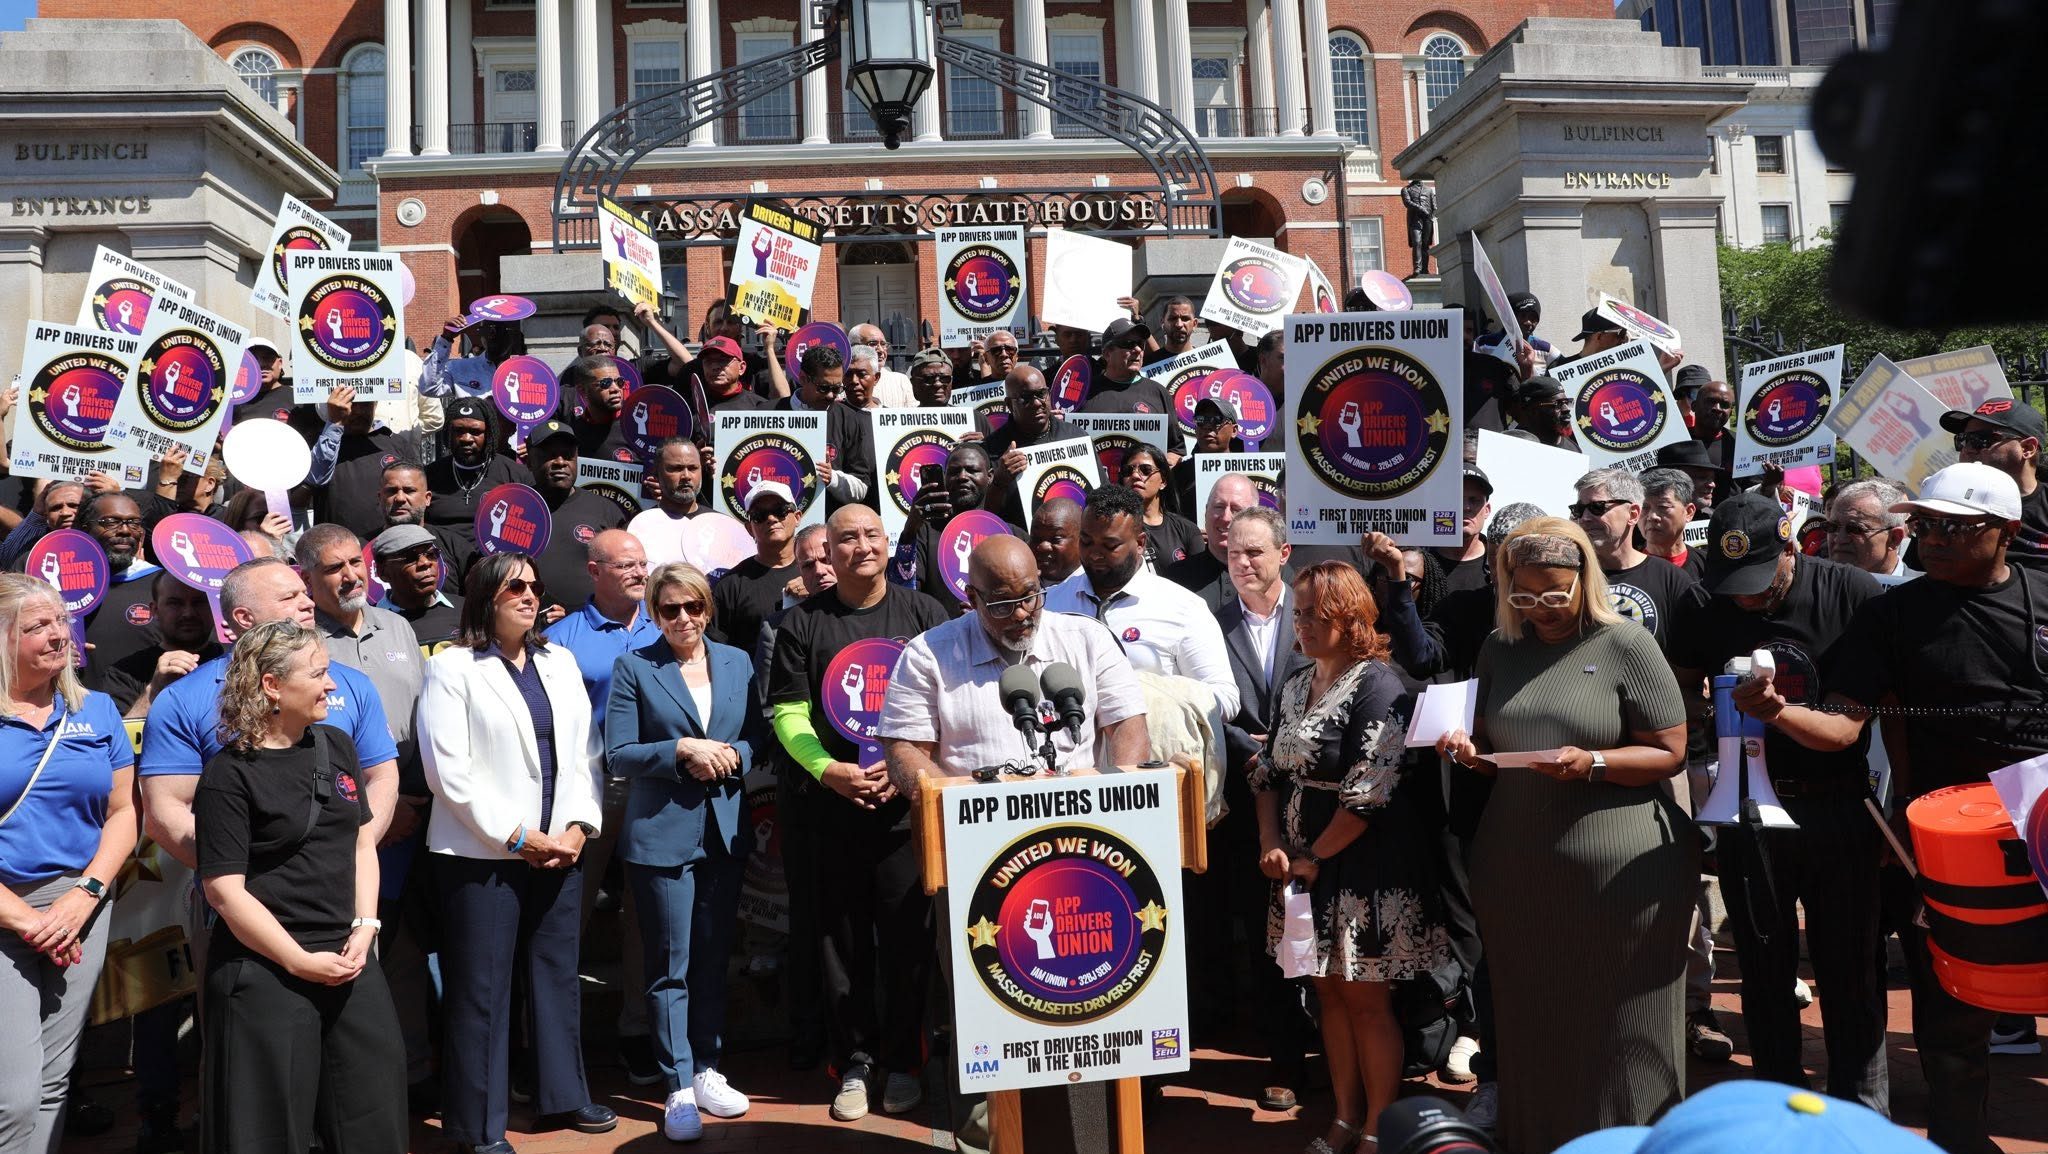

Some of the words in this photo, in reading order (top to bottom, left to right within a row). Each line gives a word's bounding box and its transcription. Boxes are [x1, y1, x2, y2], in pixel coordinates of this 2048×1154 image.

[1564, 126, 1663, 142] BULFINCH
[15, 143, 148, 161] BULFINCH
[1564, 172, 1671, 188] ENTRANCE
[12, 195, 152, 216] ENTRANCE
[603, 197, 634, 226] DRIVERS
[287, 200, 301, 214] APP
[301, 209, 327, 232] DRIVERS
[327, 226, 346, 244] UNION
[641, 203, 918, 231] ASSAUSETTS
[931, 201, 1029, 225] STATE
[1042, 199, 1157, 223] HOUSE
[752, 204, 792, 232] DRIVERS
[793, 220, 812, 240] WIN
[774, 236, 793, 252] APP
[941, 232, 956, 242] APP
[959, 231, 992, 242] DRIVERS
[994, 230, 1018, 241] UNION
[1234, 240, 1249, 250] APP
[294, 256, 315, 269] APP
[318, 257, 360, 270] DRIVERS
[364, 258, 393, 271] UNION
[772, 248, 809, 272] DRIVERS
[954, 250, 977, 268] UNITED
[991, 250, 1009, 267] WON
[103, 252, 122, 266] APP
[124, 262, 160, 286] DRIVERS
[163, 280, 188, 300] UNION
[770, 261, 797, 280] UNION
[311, 280, 342, 302] UNITED
[342, 280, 358, 288] WE
[360, 283, 382, 303] WON
[744, 292, 772, 308] DRIVERS
[760, 290, 778, 302] FIRST
[158, 297, 178, 315] APP
[178, 306, 216, 333] DRIVERS
[217, 323, 242, 345] UNION
[768, 308, 792, 322] NATION
[35, 327, 60, 342] APP
[64, 331, 114, 350] DRIVERS
[1294, 324, 1324, 343] APP
[1330, 321, 1395, 342] DRIVERS
[1401, 318, 1448, 340] UNION
[160, 334, 193, 350] UNITED
[48, 357, 87, 376] UNITED
[89, 358, 106, 369] WE
[1146, 366, 1162, 378] APP
[1164, 354, 1198, 373] DRIVERS
[1198, 344, 1224, 360] UNION
[1557, 368, 1575, 382] APP
[1576, 354, 1615, 376] DRIVERS
[1616, 344, 1645, 362] UNION
[1748, 366, 1766, 377] APP
[1768, 356, 1804, 372] DRIVERS
[1808, 350, 1835, 365] UNION
[316, 378, 334, 388] FIRST
[365, 377, 384, 386] UNION
[1317, 358, 1363, 392] UNITED
[1366, 356, 1390, 370] WE
[1393, 360, 1428, 391] WON
[520, 381, 547, 392] DRIVERS
[1582, 378, 1604, 402] UNITED
[1604, 373, 1618, 383] WE
[1620, 372, 1644, 385] WON
[1758, 378, 1786, 398] UNITED
[1802, 374, 1821, 387] WON
[519, 390, 547, 406] UNION
[952, 392, 968, 405] APP
[970, 386, 1004, 402] DRIVERS
[1363, 402, 1383, 414] APP
[722, 416, 740, 428] APP
[744, 416, 785, 428] DRIVERS
[788, 416, 818, 429] UNION
[880, 414, 898, 426] APP
[900, 413, 938, 426] DRIVERS
[941, 412, 968, 425] UNION
[1092, 420, 1130, 431] DRIVERS
[1133, 420, 1160, 432] UNION
[1363, 415, 1407, 428] DRIVERS
[896, 435, 923, 457] UNITED
[922, 434, 938, 443] WE
[1363, 430, 1406, 448] UNION
[734, 440, 764, 460] UNITED
[766, 438, 782, 448] WE
[782, 440, 804, 461] WON
[1034, 448, 1066, 464] DRIVERS
[1066, 443, 1088, 458] UNION
[1796, 446, 1814, 456] UNION
[38, 453, 60, 464] FIRST
[62, 456, 95, 468] DRIVERS
[98, 460, 121, 471] UNION
[1202, 460, 1222, 472] APP
[1225, 459, 1266, 472] DRIVERS
[1311, 447, 1384, 492] MASSACHUSETTS
[1382, 470, 1420, 490] DRIVERS
[1417, 447, 1438, 473] FIRST
[580, 463, 620, 481] DRIVERS
[1036, 473, 1056, 498] UNITED
[1069, 472, 1087, 489] WON
[510, 504, 525, 517] APP
[1319, 508, 1347, 522] FIRST
[1350, 508, 1392, 522] DRIVERS
[1396, 508, 1426, 522] UNION
[506, 516, 537, 533] DRIVERS
[1292, 520, 1316, 530] IAM
[1336, 522, 1348, 534] IN
[1350, 522, 1369, 534] THE
[1372, 522, 1408, 534] NATION
[192, 532, 210, 544] APP
[501, 529, 534, 548] UNION
[60, 551, 76, 563] APP
[194, 542, 234, 556] DRIVERS
[60, 560, 94, 573] DRIVERS
[198, 554, 238, 570] UNION
[61, 573, 95, 591] UNION
[1609, 586, 1632, 596] MAND
[1632, 592, 1655, 618] JUSTICE
[866, 664, 888, 678] APP
[326, 696, 345, 707] AM
[846, 717, 862, 732] IAM
[958, 796, 1000, 825] APP
[1006, 789, 1092, 821] DRIVERS
[1098, 782, 1160, 813] UNION
[990, 842, 1053, 890] UNITED
[1056, 836, 1088, 855] WE
[1091, 840, 1136, 878] WON
[1055, 896, 1081, 914] APP
[1056, 912, 1112, 934] DRIVERS
[1056, 932, 1113, 957] UNION
[987, 962, 1083, 1015] MASSACHUSETTS
[1082, 979, 1133, 1014] DRIVERS
[1128, 950, 1154, 985] FIRST
[1030, 966, 1046, 982] IAM
[1044, 973, 1068, 988] UNION
[1078, 973, 1097, 987] 32BJ
[1094, 962, 1112, 981] SEIU
[1153, 1029, 1178, 1039] 32BJ
[1003, 1040, 1040, 1059] FIRST
[1044, 1034, 1100, 1056] DRIVERS
[1103, 1030, 1143, 1049] UNION
[1155, 1048, 1178, 1057] SEIU
[965, 1059, 999, 1074] IAM
[1028, 1056, 1041, 1073] IN
[1046, 1052, 1070, 1072] THE
[1074, 1048, 1121, 1068] NATION
